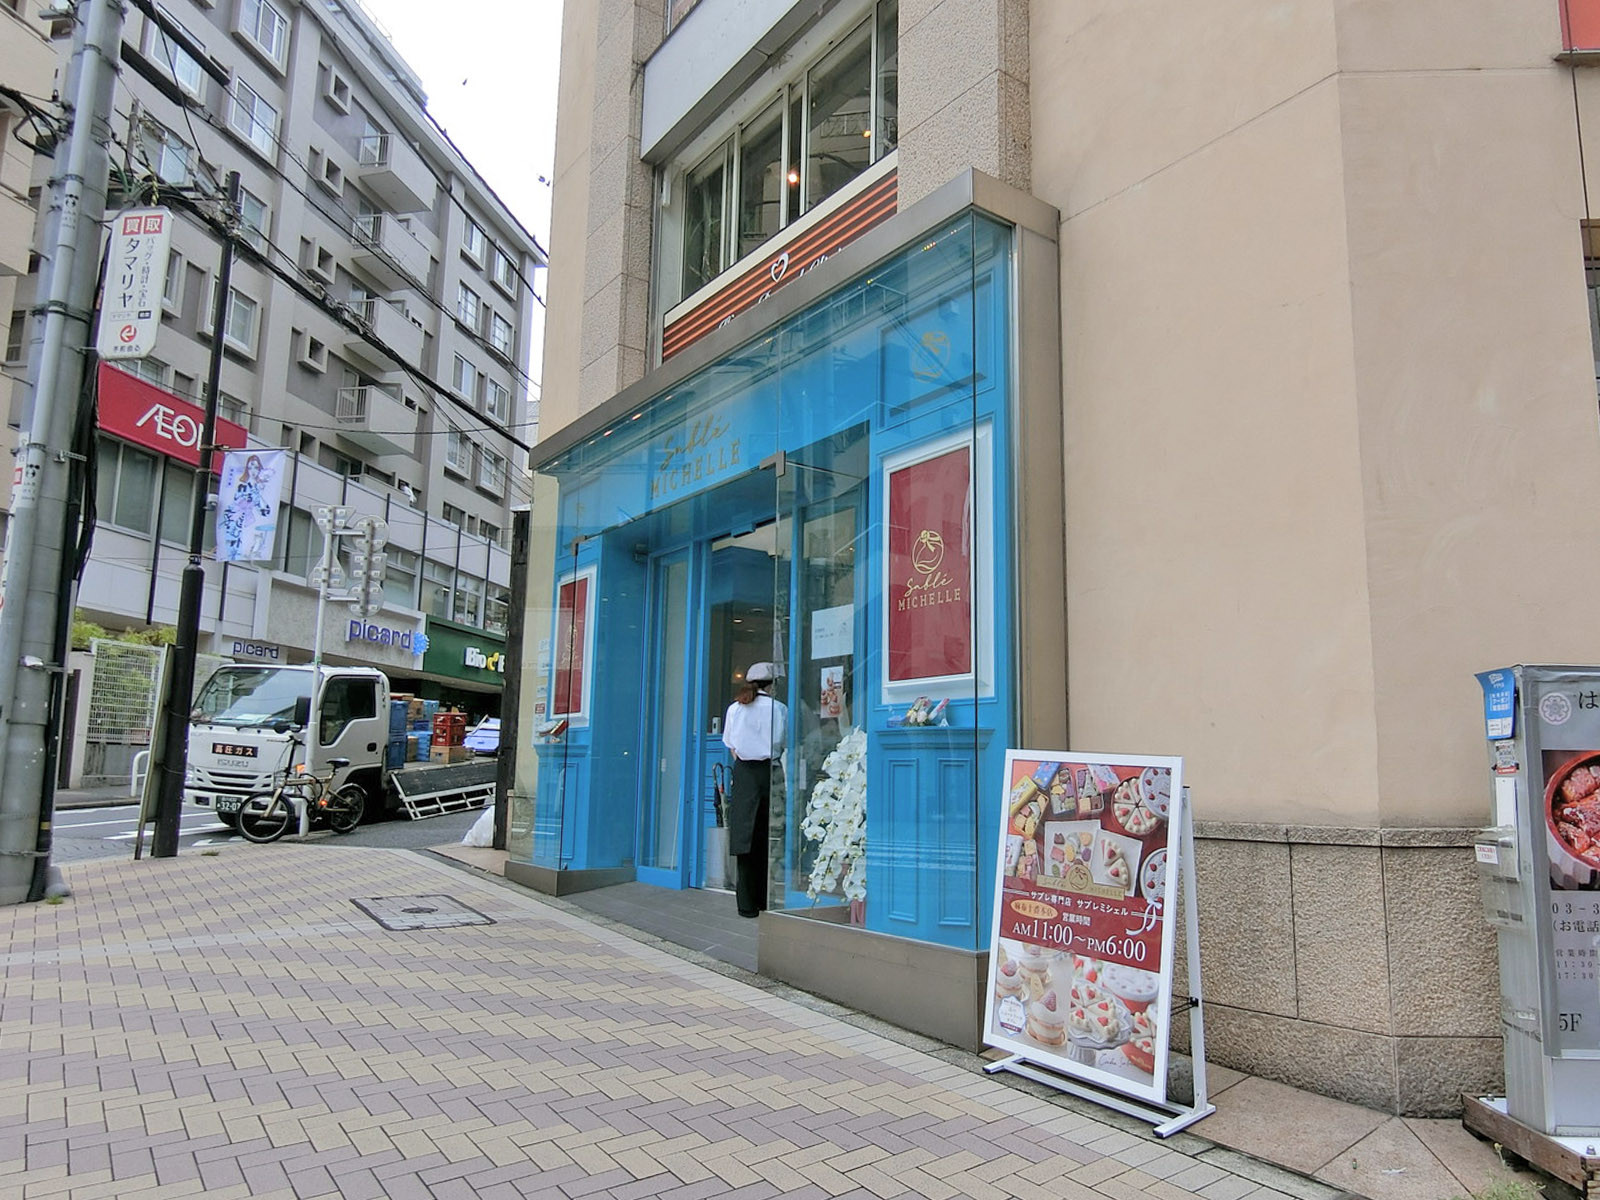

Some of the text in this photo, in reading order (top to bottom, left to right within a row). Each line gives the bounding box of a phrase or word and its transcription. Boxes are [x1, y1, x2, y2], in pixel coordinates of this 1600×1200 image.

[124, 217, 162, 234] 買取
[117, 238, 140, 308] タマリヤ
[651, 438, 740, 499] MICHELLE
[898, 588, 960, 611] MICHELLE
[349, 619, 412, 649] picard
[233, 640, 279, 659] picard
[465, 646, 487, 669] Bio
[1578, 690, 1599, 709] は
[215, 744, 253, 756] 高圧ガス
[217, 759, 249, 768] ISUZU
[1031, 891, 1072, 907] サブレ専門店
[1076, 899, 1129, 916] サブレミシェル
[1062, 912, 1091, 926] 営業時間
[1559, 1013, 1582, 1032] 5F
